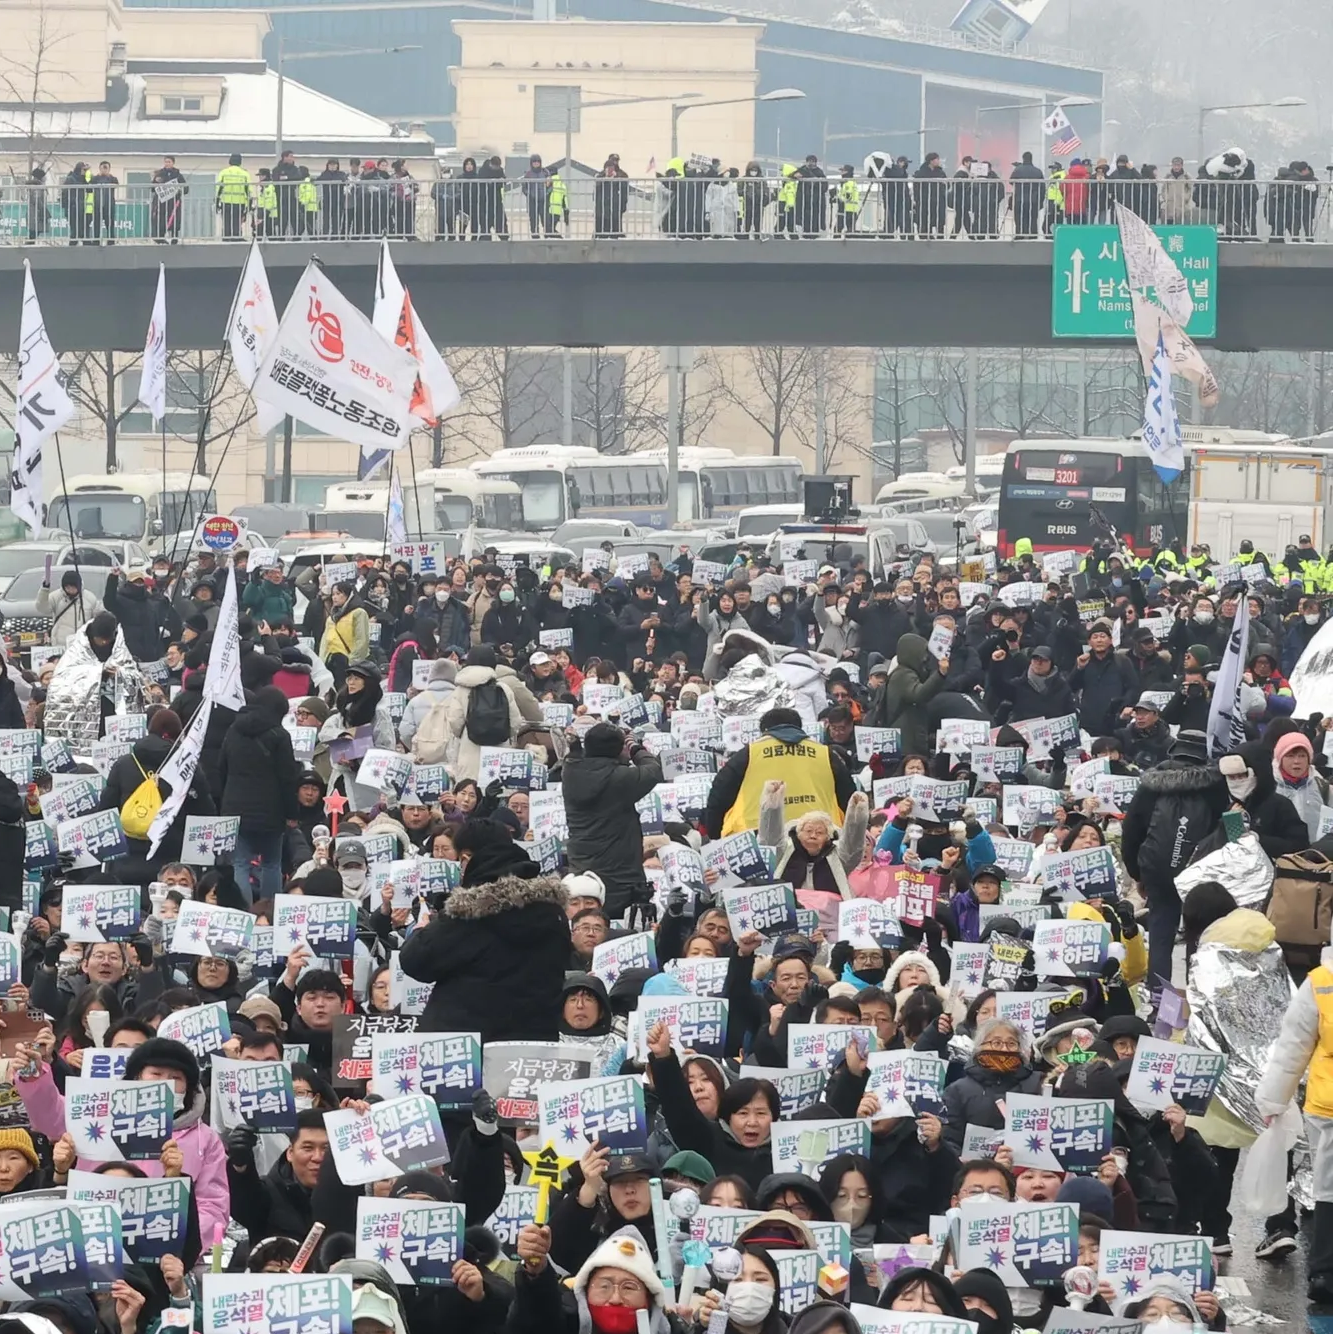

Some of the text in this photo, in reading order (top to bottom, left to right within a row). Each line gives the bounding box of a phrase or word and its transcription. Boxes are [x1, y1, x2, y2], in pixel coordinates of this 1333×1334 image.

[1184, 257, 1209, 270] Hall
[1056, 470, 1078, 484] 3201
[1047, 525, 1077, 535] RBUS
[763, 744, 816, 758] 의료지원단
[1171, 816, 1189, 869] Columbia
[347, 1016, 420, 1037] 지금당장
[378, 1044, 418, 1061] 내란수괴
[420, 1037, 473, 1069] 체포!
[378, 1058, 418, 1074] 윤석열
[504, 1057, 579, 1080] 지금당장
[423, 1068, 473, 1095] 구속!
[1051, 1102, 1107, 1129] 체포!
[1052, 1129, 1106, 1155] 구속!
[968, 1216, 1012, 1233] 내란수괴
[1013, 1208, 1071, 1240] 체포!
[967, 1230, 1011, 1247] 윤석열
[1013, 1239, 1071, 1267] 구속!
[212, 1290, 264, 1311] 내란수괴
[267, 1279, 340, 1318] 체포!
[212, 1306, 263, 1328] 윤석열
